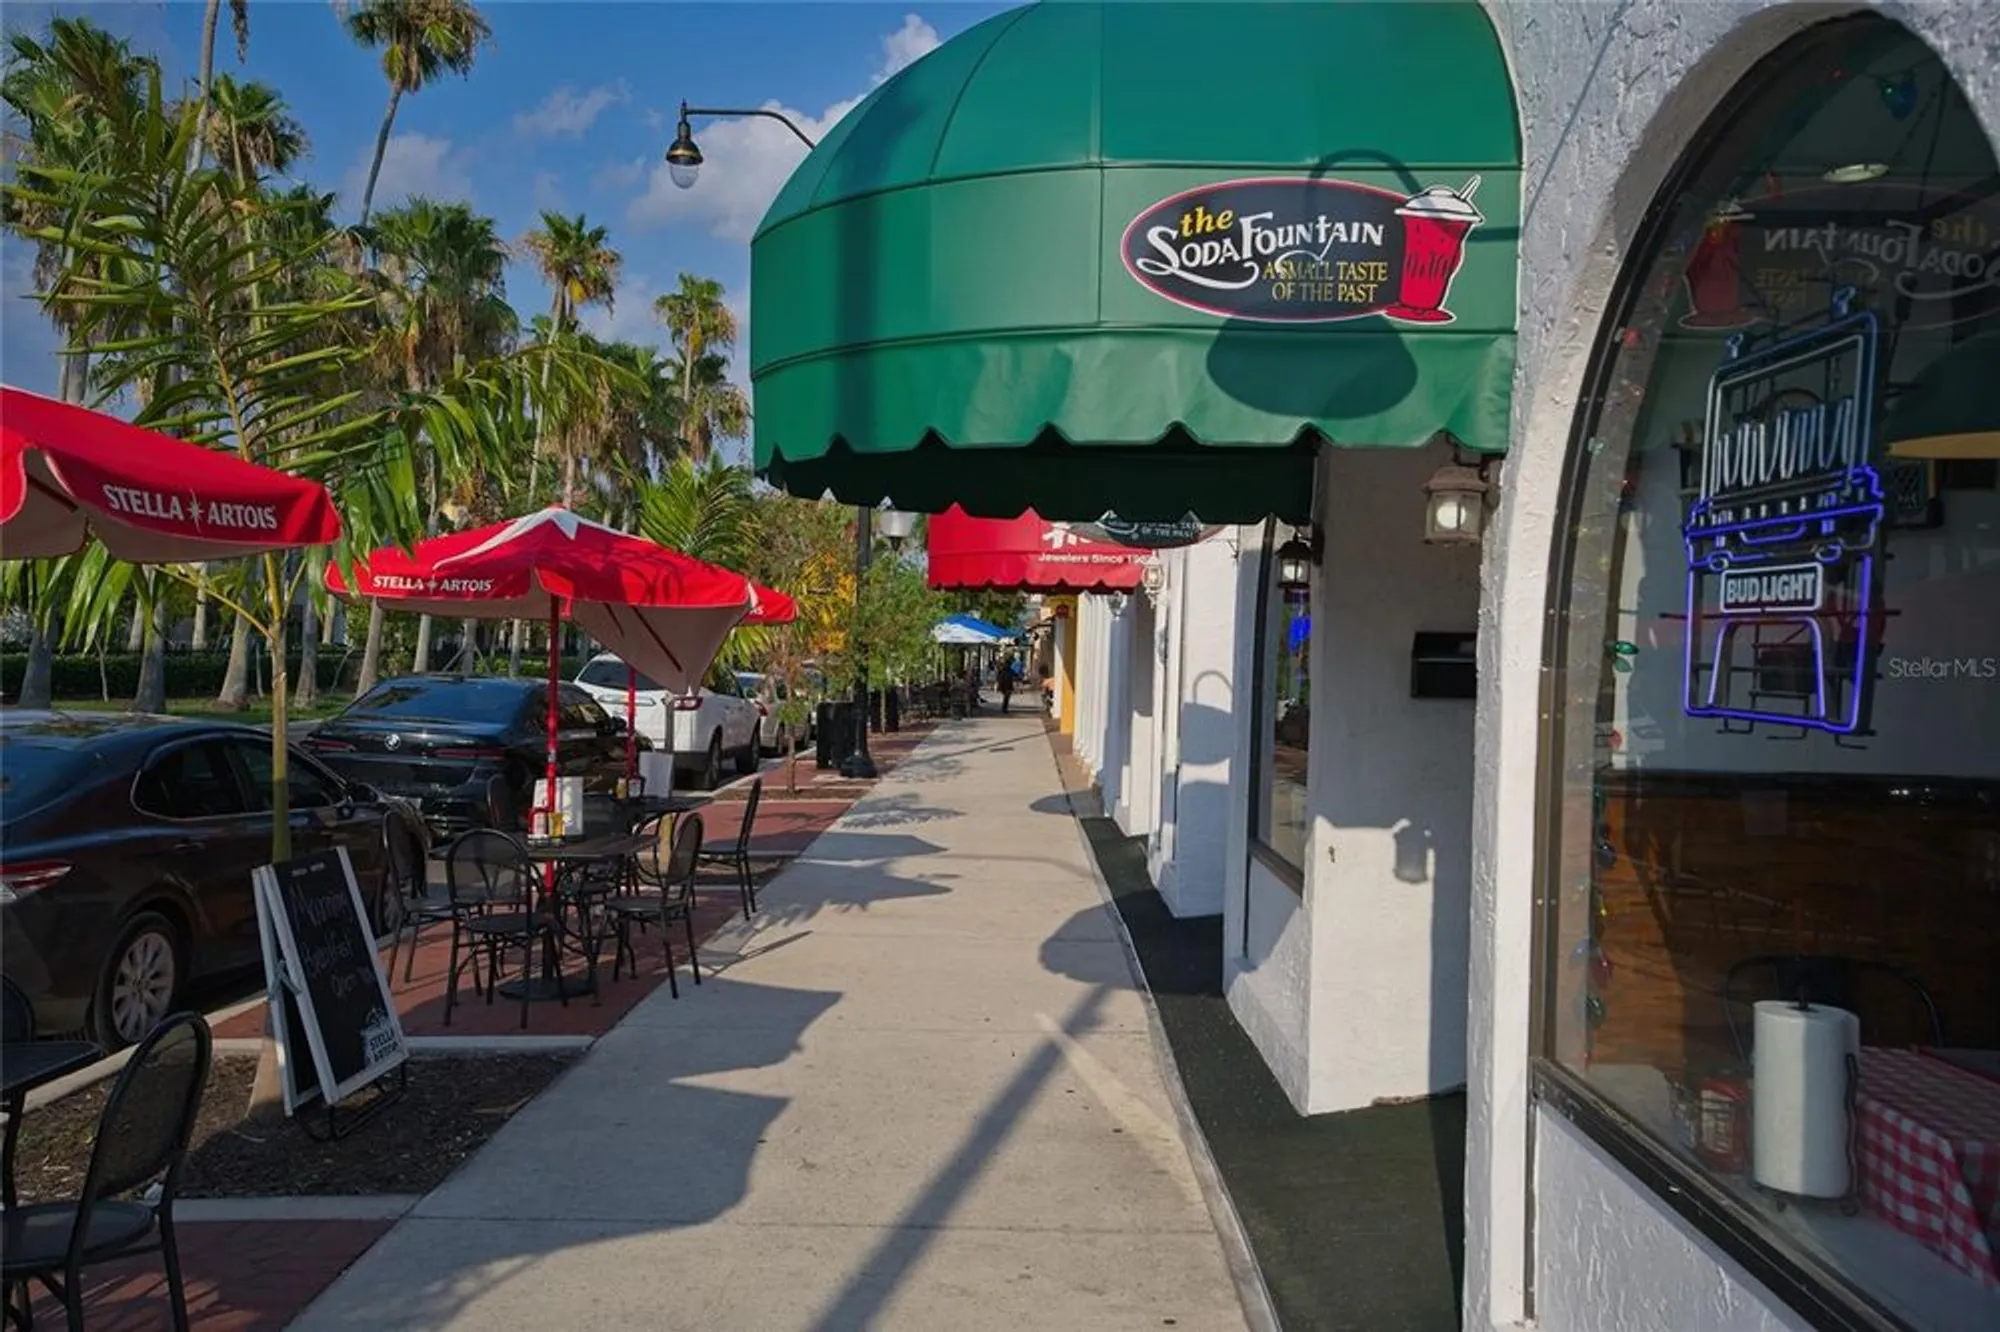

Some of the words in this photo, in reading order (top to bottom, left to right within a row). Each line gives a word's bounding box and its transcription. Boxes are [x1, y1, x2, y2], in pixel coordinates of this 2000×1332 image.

[1181, 206, 1233, 237] the
[1262, 261, 1275, 280] A
[1278, 260, 1334, 281] SMALL
[1336, 261, 1388, 281] TASTE
[1272, 282, 1296, 301] OF
[1301, 282, 1333, 301] THE
[1337, 283, 1378, 303] PAST
[103, 483, 184, 521] STELLA
[207, 501, 277, 530] ARTOIS
[1038, 552, 1090, 563] Jewelers
[1092, 553, 1123, 564] Since
[373, 575, 424, 591] STELLA
[440, 578, 492, 592] ARTOIS
[1727, 577, 1760, 603] BUD
[1761, 572, 1815, 602] LIGHT
